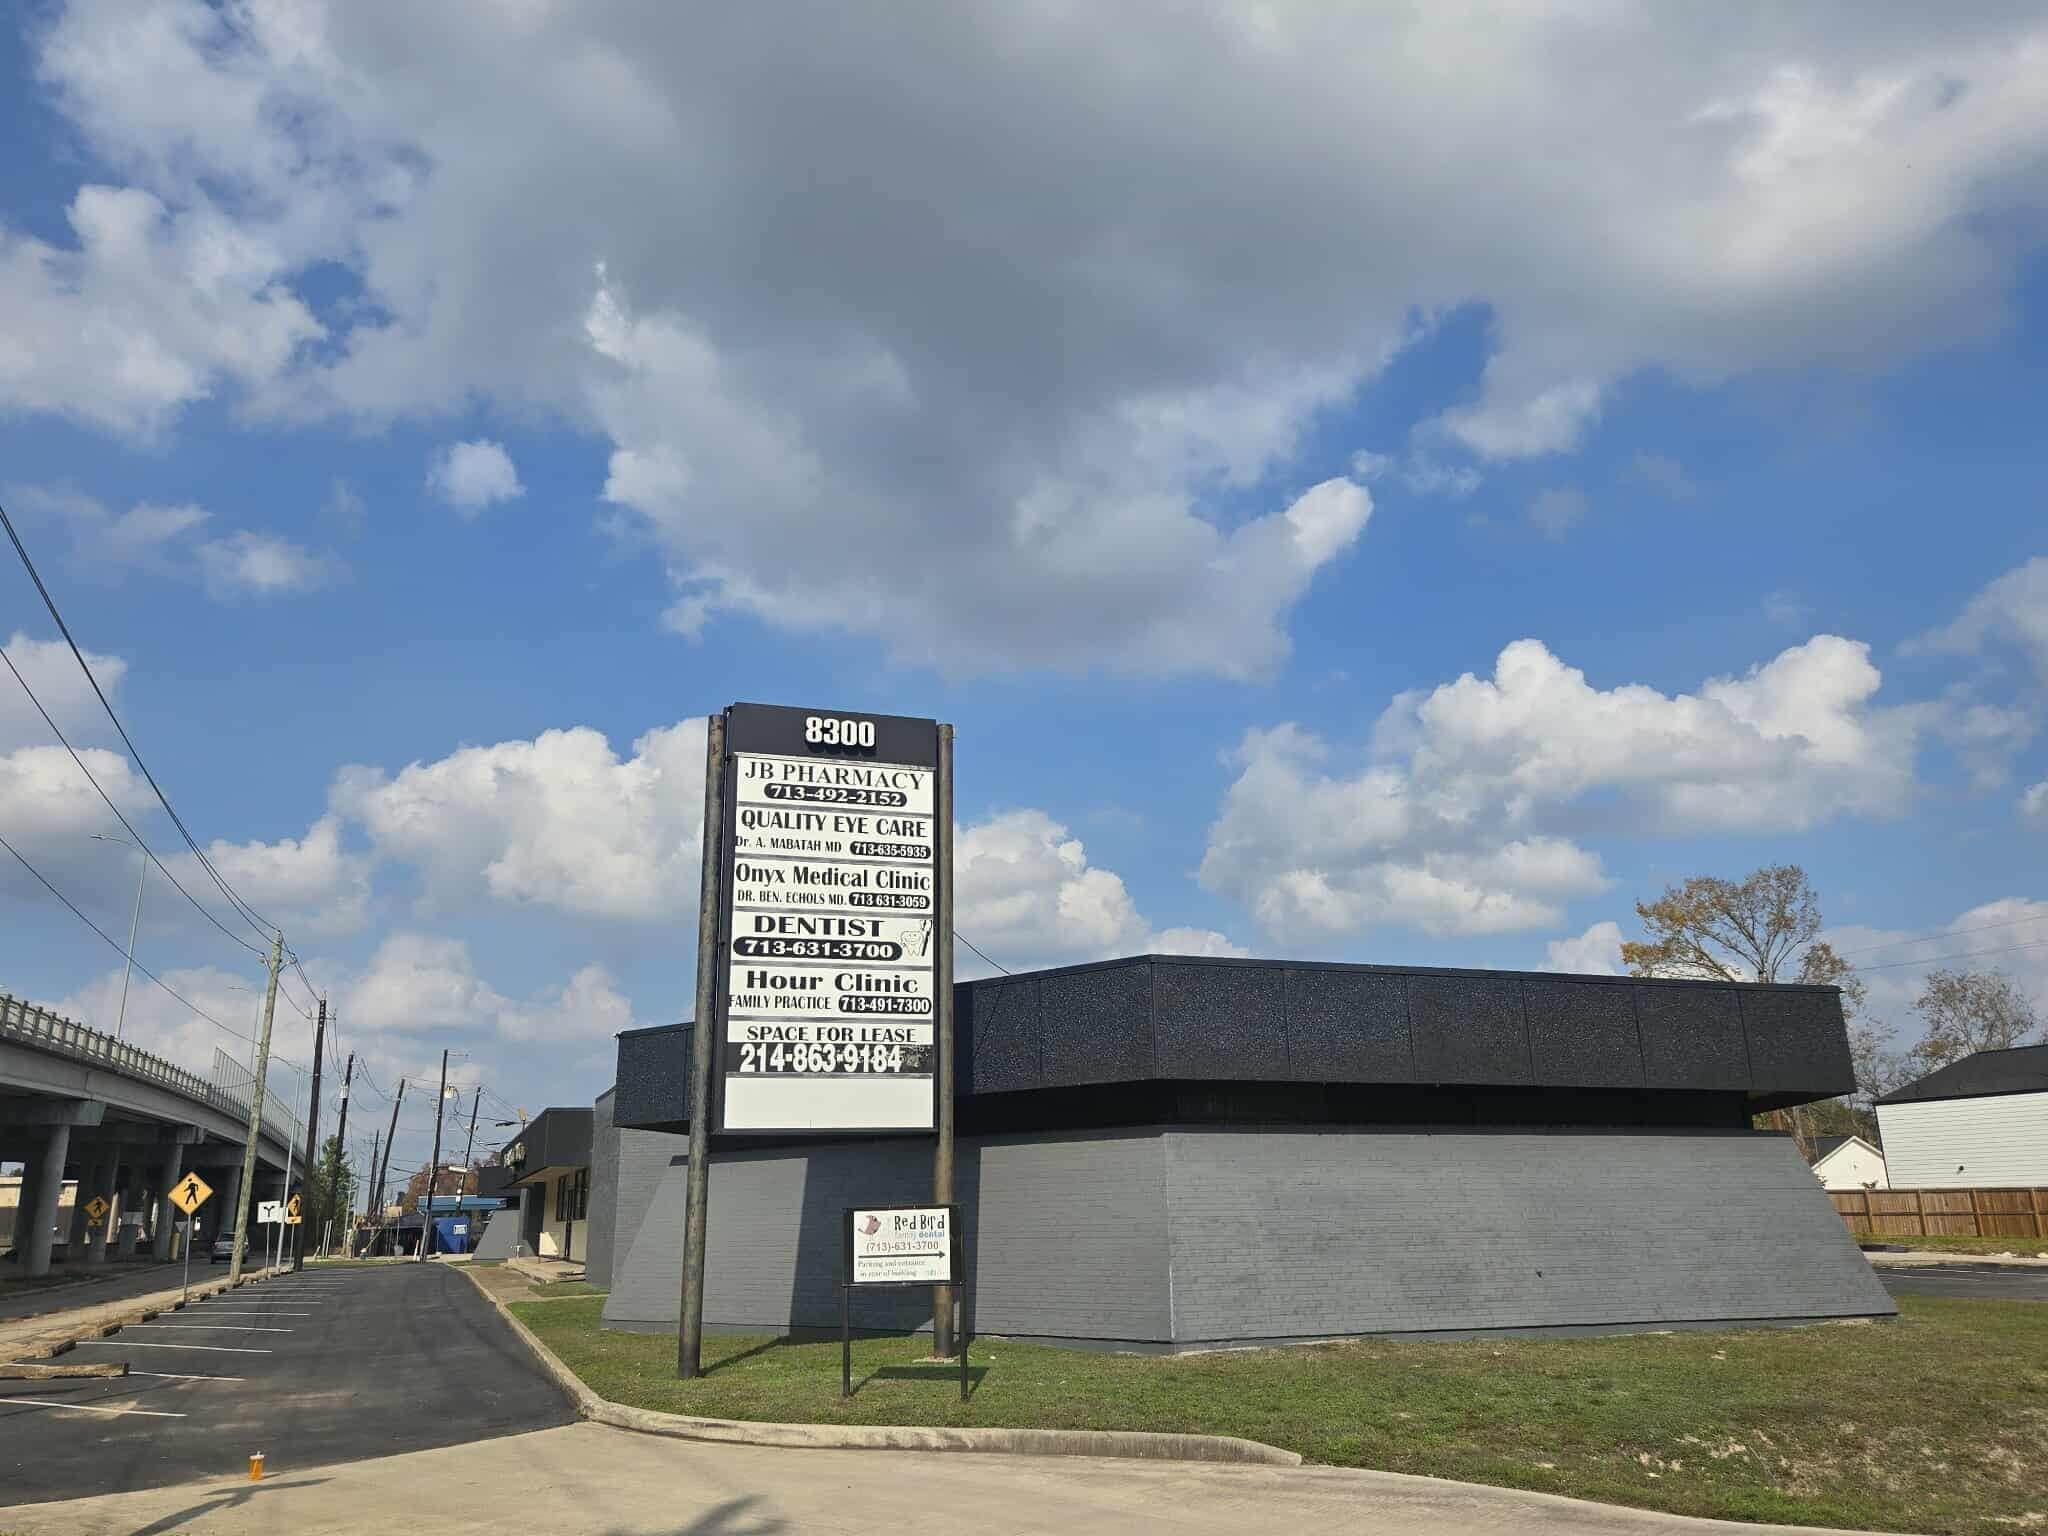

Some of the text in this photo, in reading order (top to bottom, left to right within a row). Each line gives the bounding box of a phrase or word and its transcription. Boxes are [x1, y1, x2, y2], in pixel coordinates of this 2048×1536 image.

[806, 717, 875, 746] 8300
[745, 762, 924, 790] JB PHARMACY
[770, 785, 902, 804] 713-492-2152
[741, 809, 928, 837] QUALITY EYE CARE
[756, 837, 765, 848] A.
[770, 838, 821, 851] MABATAH
[825, 842, 841, 852] MD
[737, 864, 930, 890] Onyx Medical Clinic
[738, 890, 755, 902] DR.
[786, 893, 824, 905] ECHOLS
[755, 916, 886, 937] DENTIST
[745, 940, 893, 958] 713-631-3700
[747, 971, 918, 992] Hour Clinic
[729, 995, 929, 1012] FAMILY PRACTICE 713-491-7300
[747, 1026, 917, 1042] SPACE FOR LEASE
[740, 1044, 903, 1072] 214-863-9184
[895, 1215, 944, 1230] Red Bird
